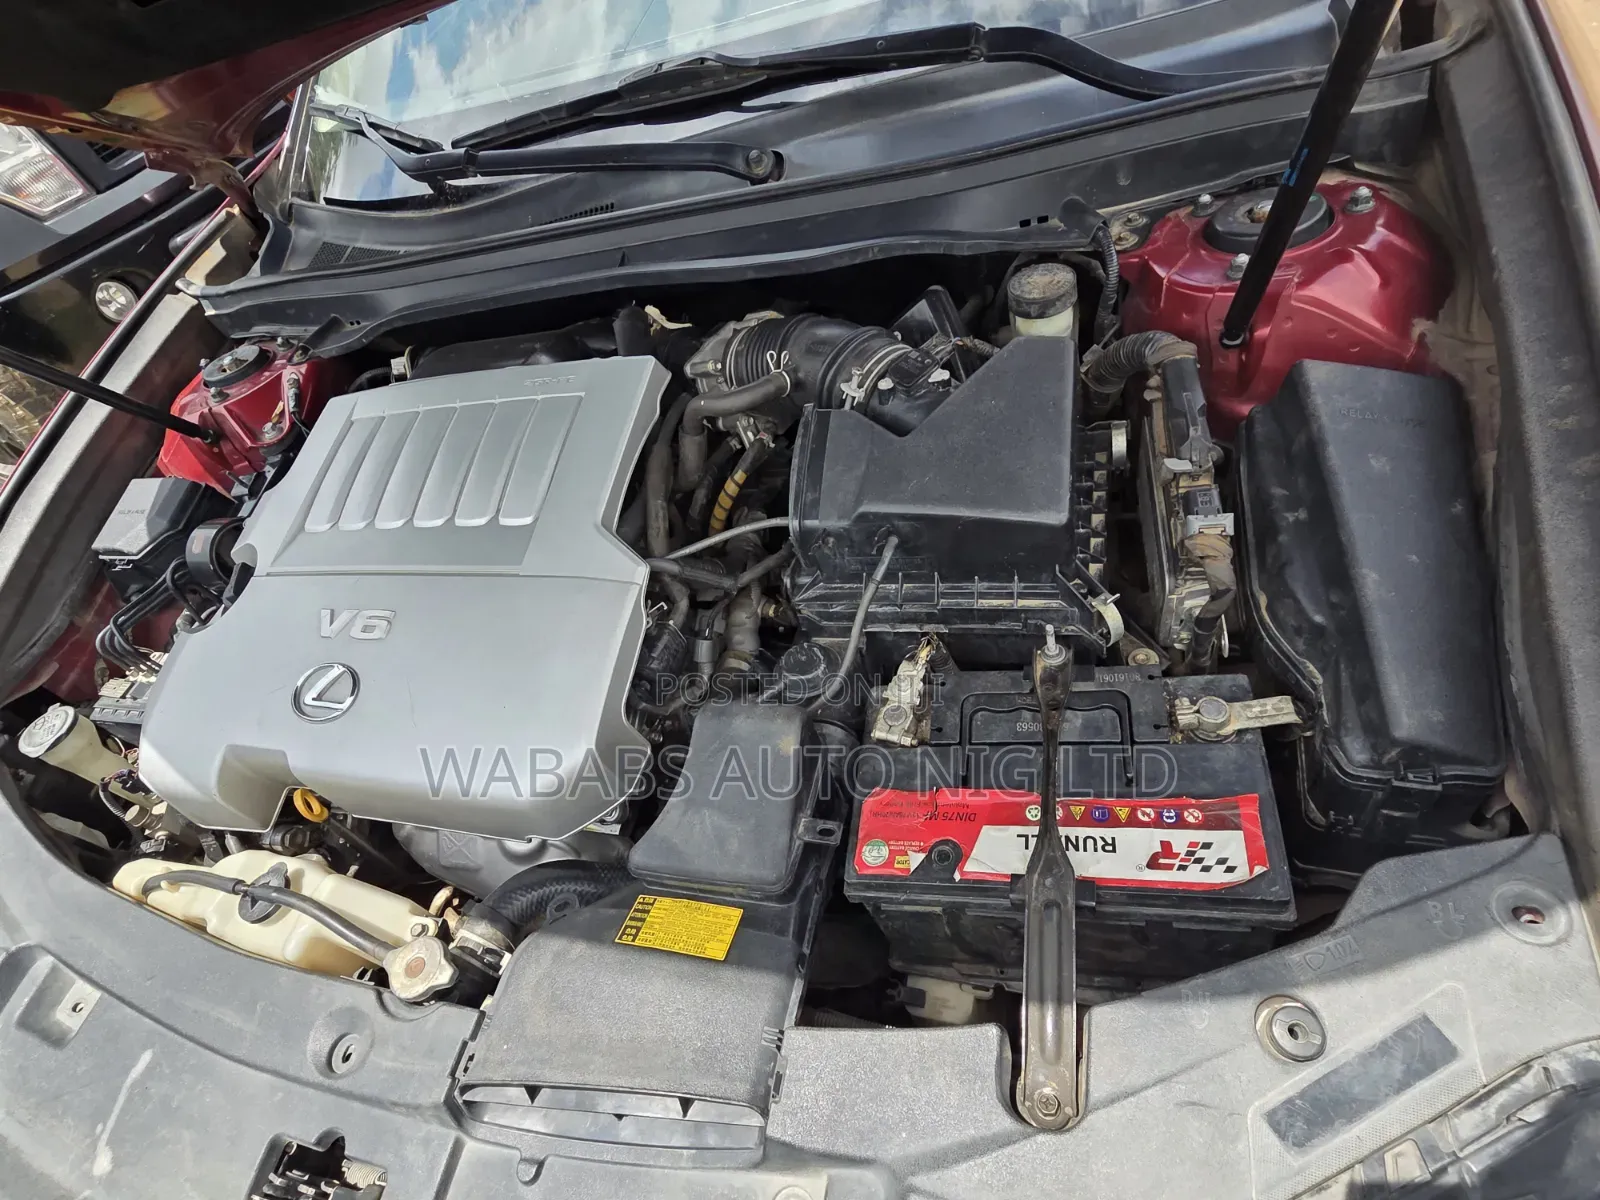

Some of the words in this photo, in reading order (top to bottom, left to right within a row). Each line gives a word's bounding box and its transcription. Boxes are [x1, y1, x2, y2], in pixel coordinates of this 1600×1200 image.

[320, 608, 397, 640] V6
[942, 811, 977, 822] DIN75
[1017, 834, 1118, 853] RUNL
